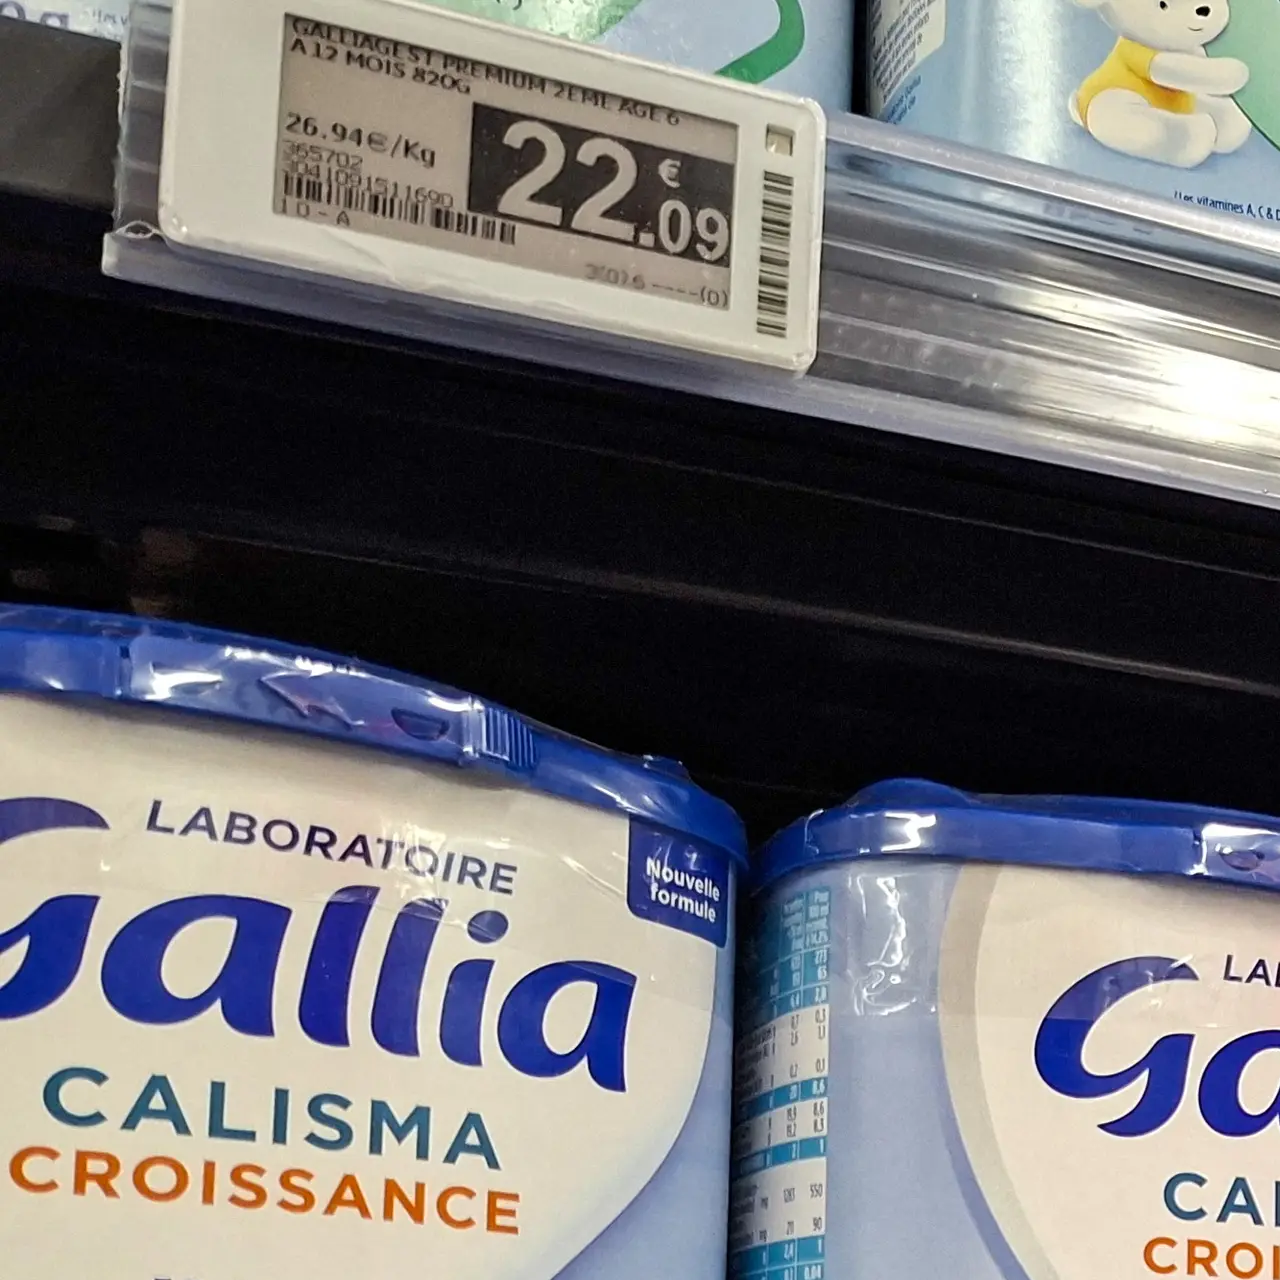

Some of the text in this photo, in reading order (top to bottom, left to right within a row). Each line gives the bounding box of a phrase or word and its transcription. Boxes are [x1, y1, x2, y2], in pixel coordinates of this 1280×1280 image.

[313, 40, 337, 62] 12
[345, 49, 405, 79] MOIS
[412, 67, 471, 94] 820G
[285, 114, 435, 168] 26.94€/Kg
[146, 799, 519, 897] LABORATOIRE
[645, 856, 721, 901] Nouvelle
[650, 881, 717, 924] formule
[42, 1067, 501, 1170] CALISMA
[8, 1146, 521, 1234] CROISSANCE
